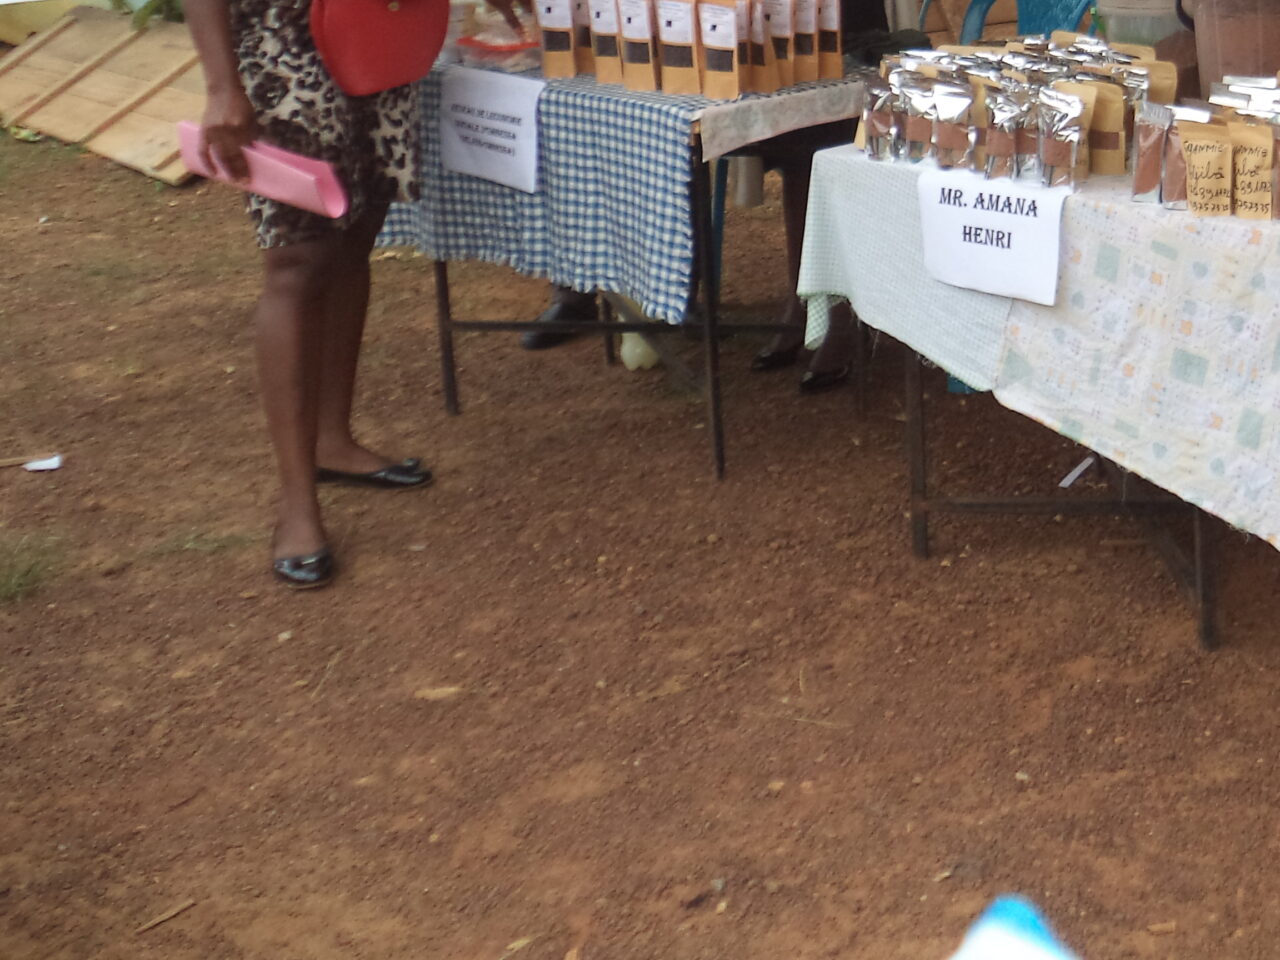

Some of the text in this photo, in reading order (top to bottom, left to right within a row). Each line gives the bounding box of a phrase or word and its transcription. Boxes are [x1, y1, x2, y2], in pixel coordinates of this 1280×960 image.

[939, 187, 1039, 218] MR. AMANA
[962, 225, 1012, 249] HENRI
